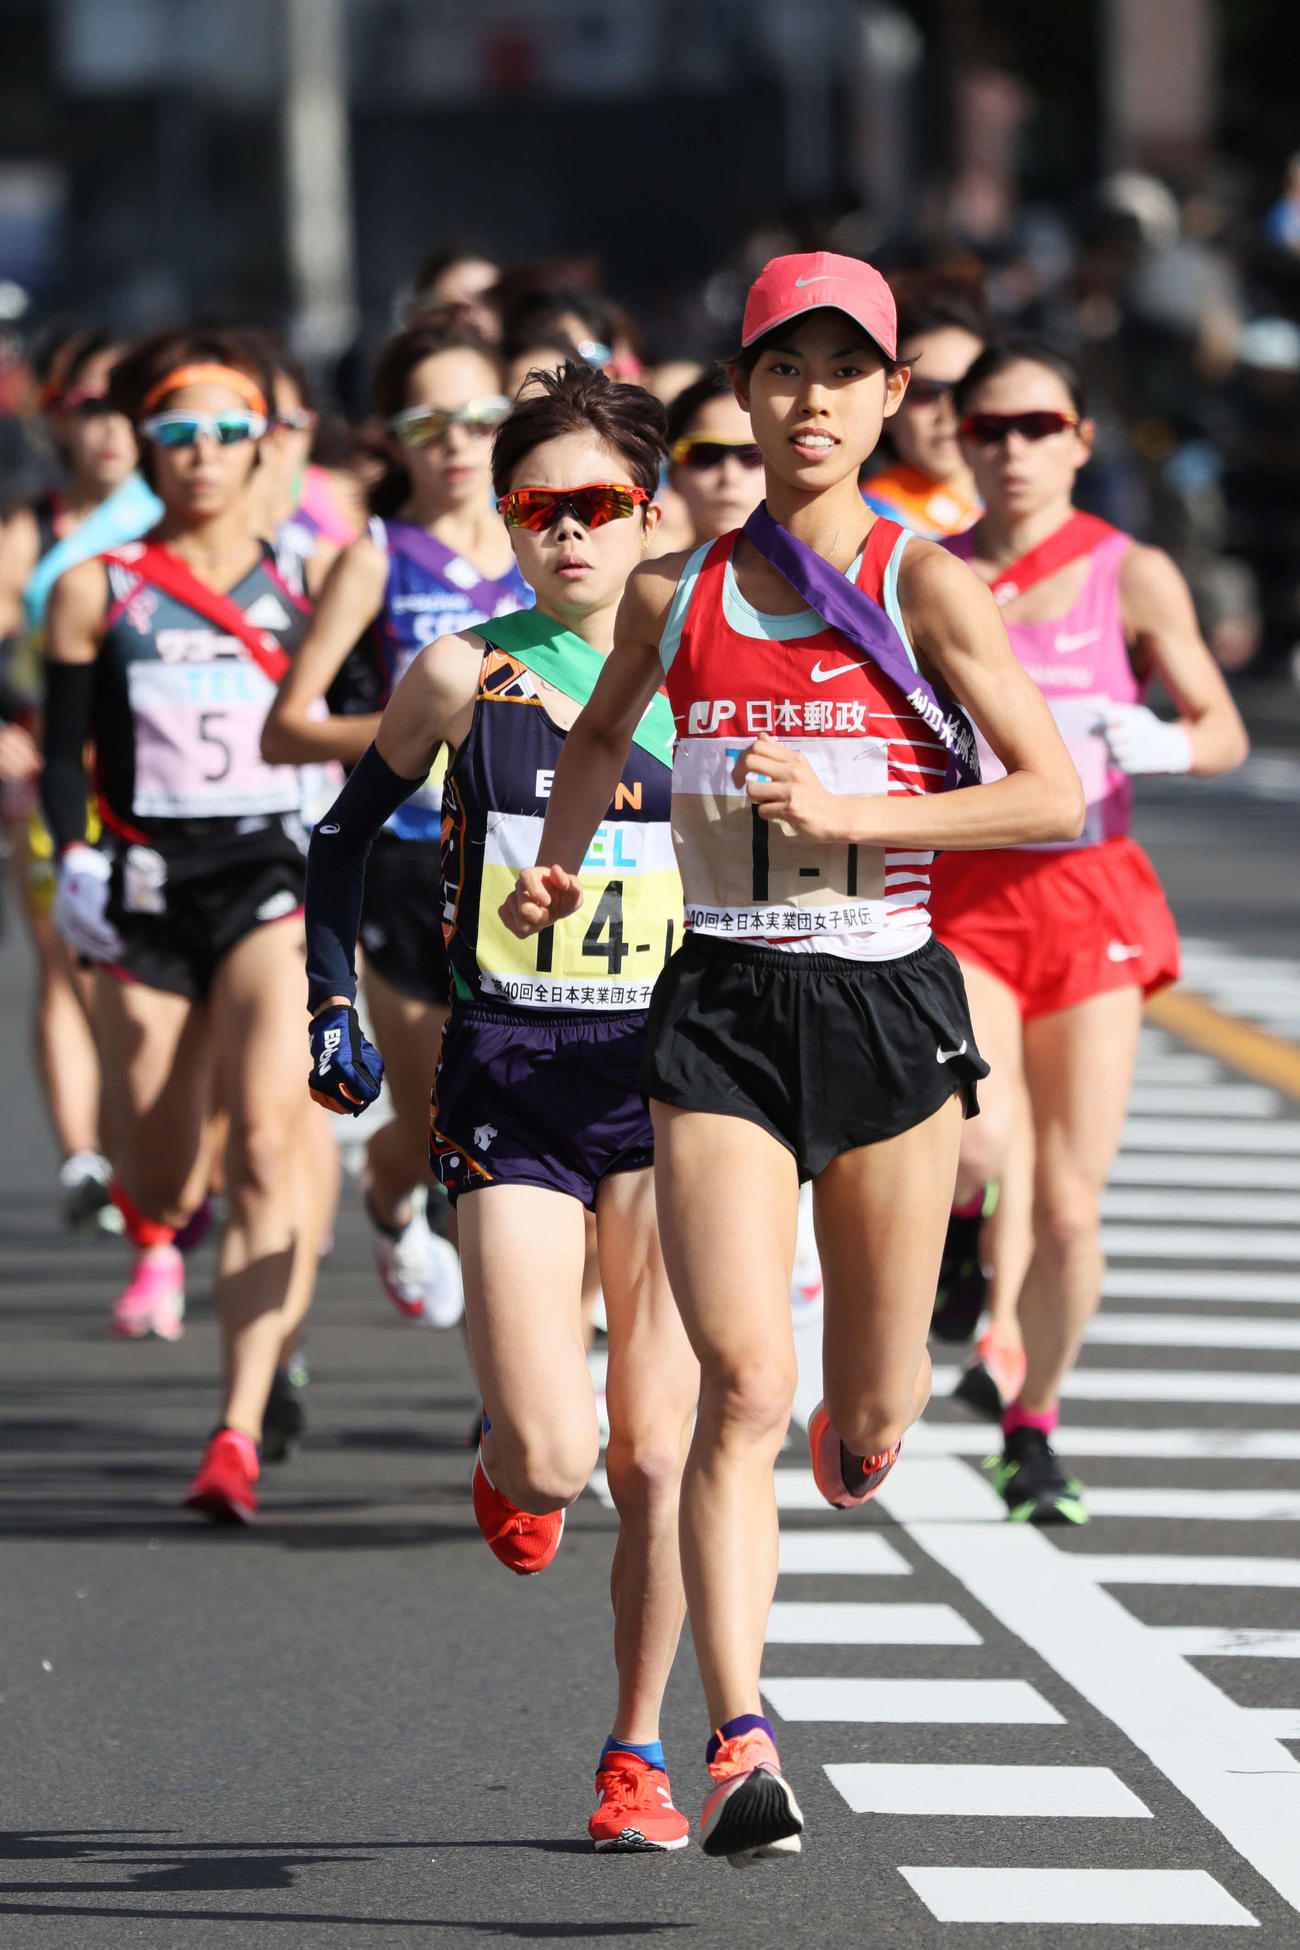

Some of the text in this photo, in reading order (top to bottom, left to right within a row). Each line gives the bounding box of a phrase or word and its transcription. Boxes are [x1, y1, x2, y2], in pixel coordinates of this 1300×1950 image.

[746, 699, 867, 733] 日本郵政
[582, 829, 637, 867] EL
[752, 803, 858, 901] 1-1
[318, 1028, 341, 1077] EDION
